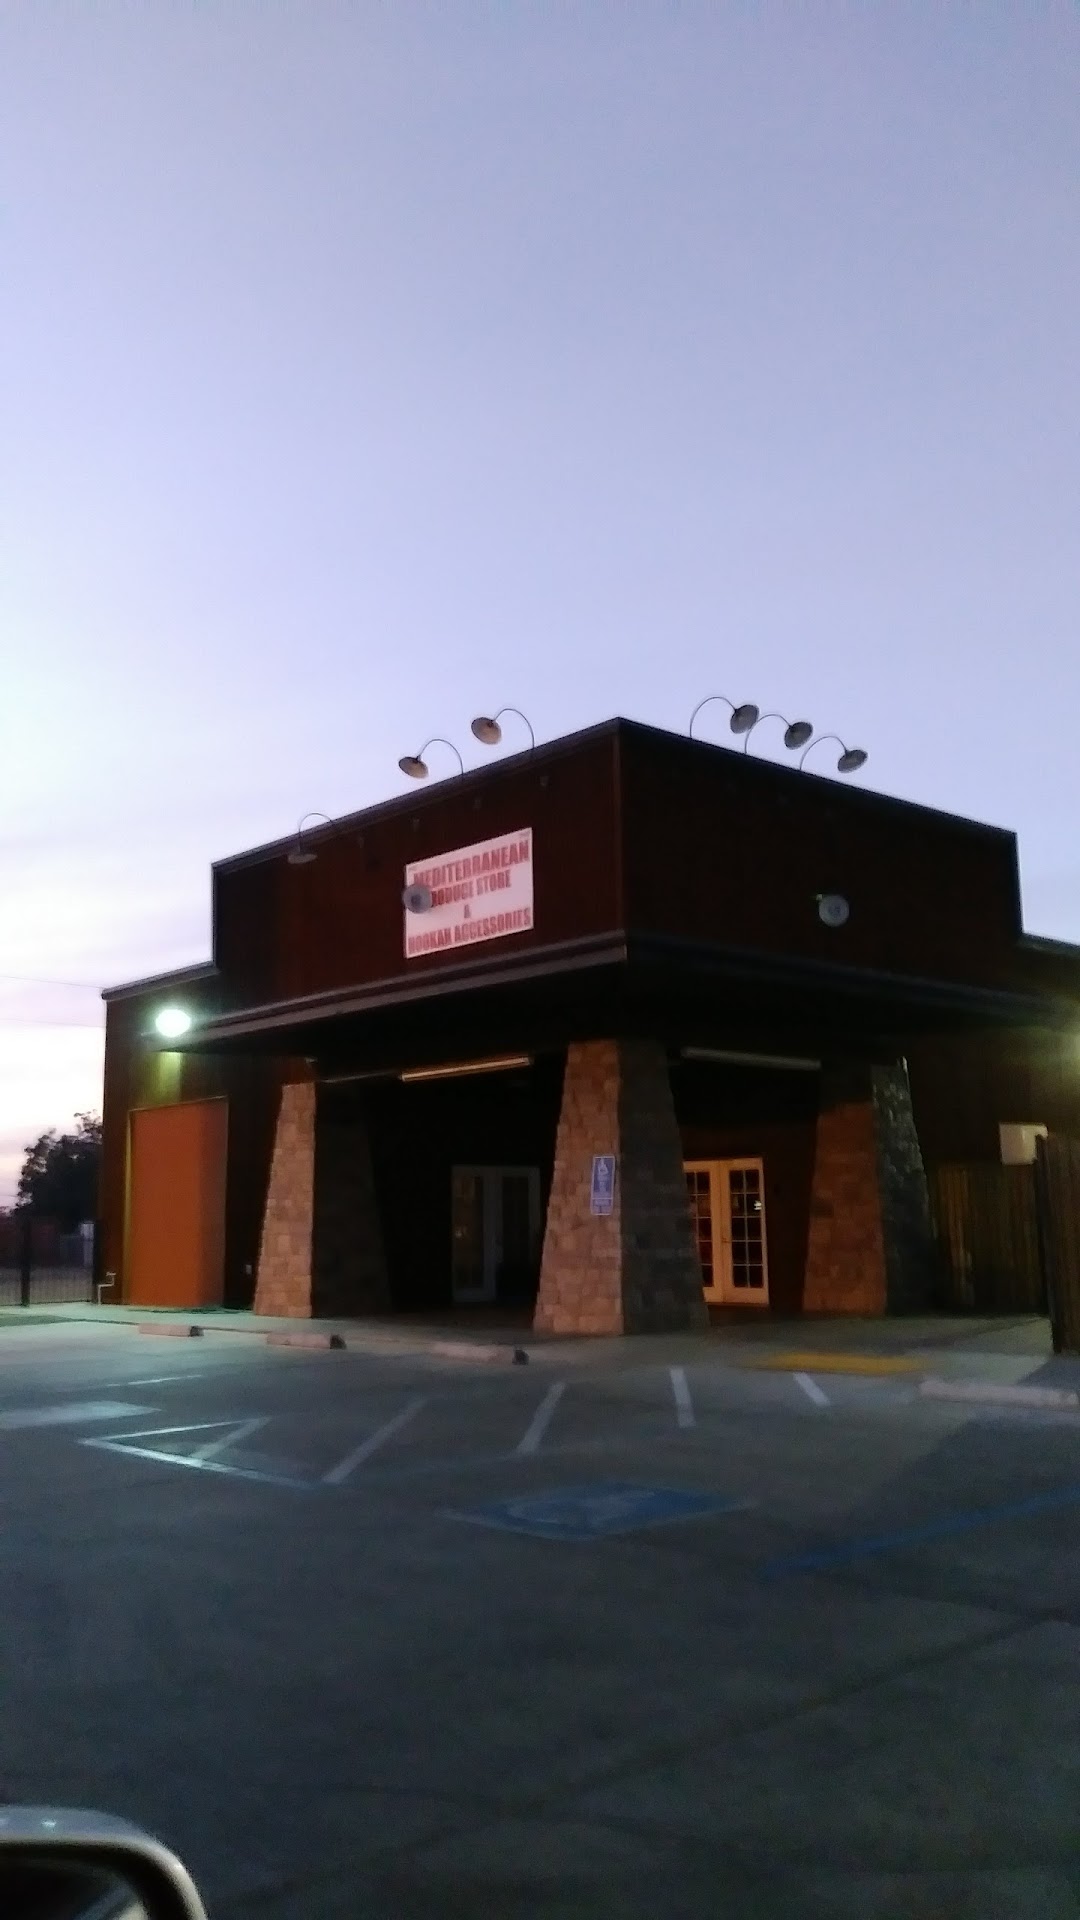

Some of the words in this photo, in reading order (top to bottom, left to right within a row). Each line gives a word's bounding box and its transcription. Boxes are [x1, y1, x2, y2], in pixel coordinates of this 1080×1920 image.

[413, 839, 530, 892] MEDITERRANEAN
[475, 868, 512, 896] STORE
[408, 927, 452, 955] HOOKAH
[454, 907, 531, 942] ACCESSORIES
